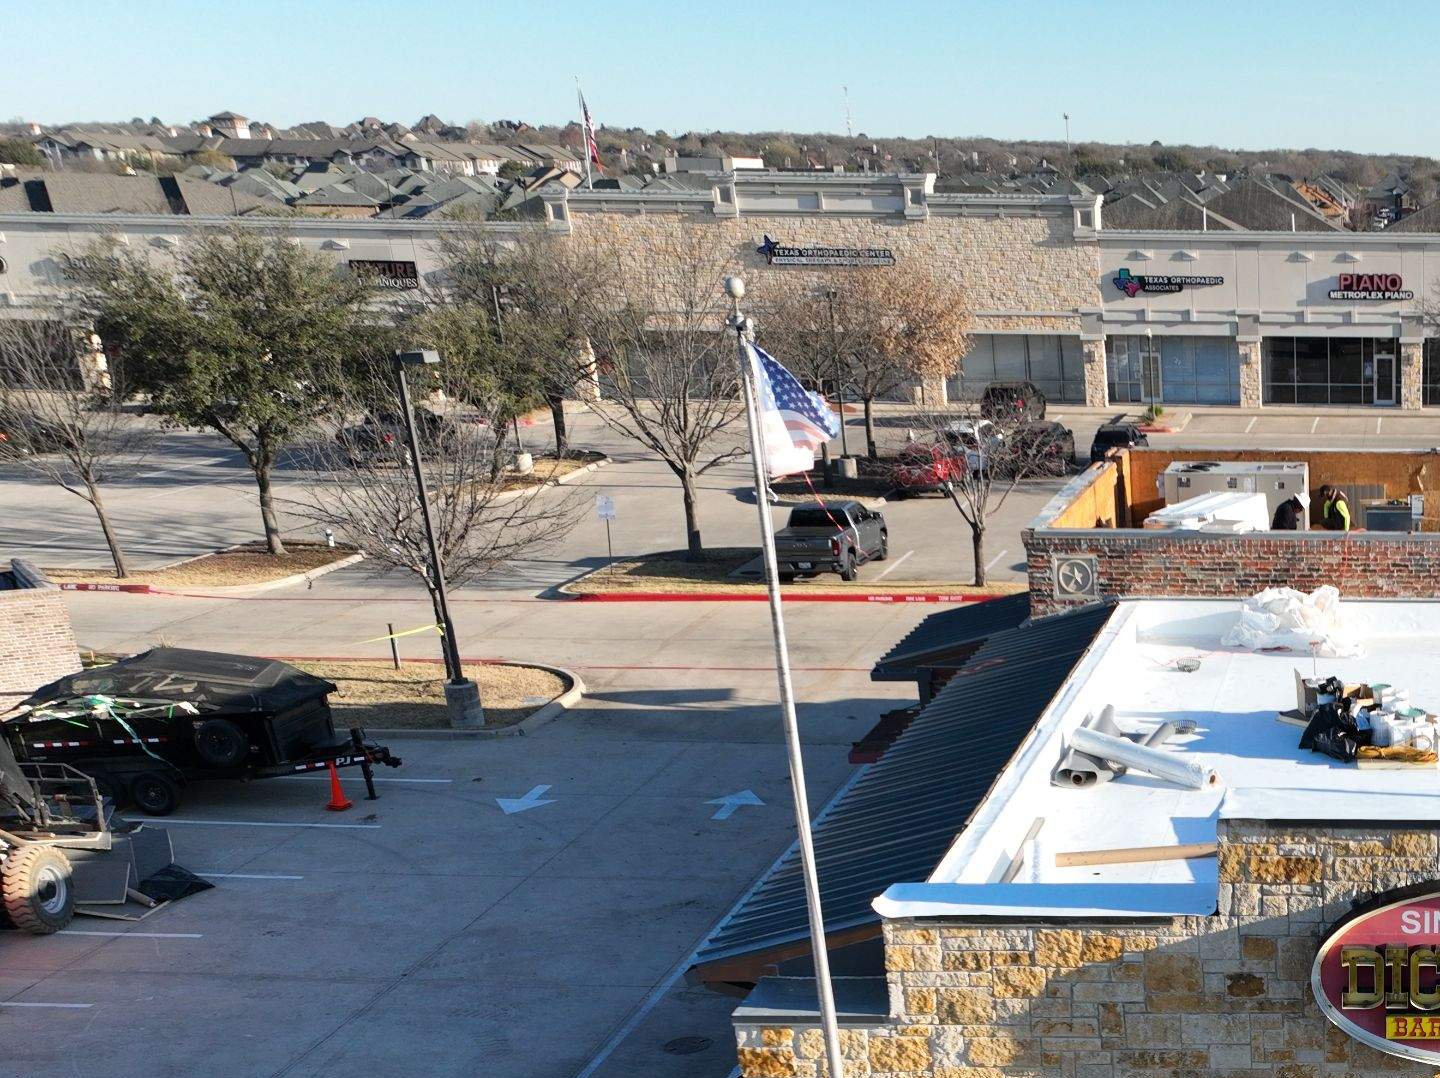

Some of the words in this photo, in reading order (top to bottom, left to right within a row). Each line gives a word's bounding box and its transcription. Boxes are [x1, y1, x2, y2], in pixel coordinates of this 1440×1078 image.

[801, 250, 859, 258] ORTHOPAEDIC
[1170, 277, 1224, 285] ORTHOPAEDIC
[1340, 273, 1402, 292] PIANO
[1329, 291, 1384, 300] METROPLEX
[1384, 292, 1414, 300] PIANO
[335, 756, 351, 766] PJ
